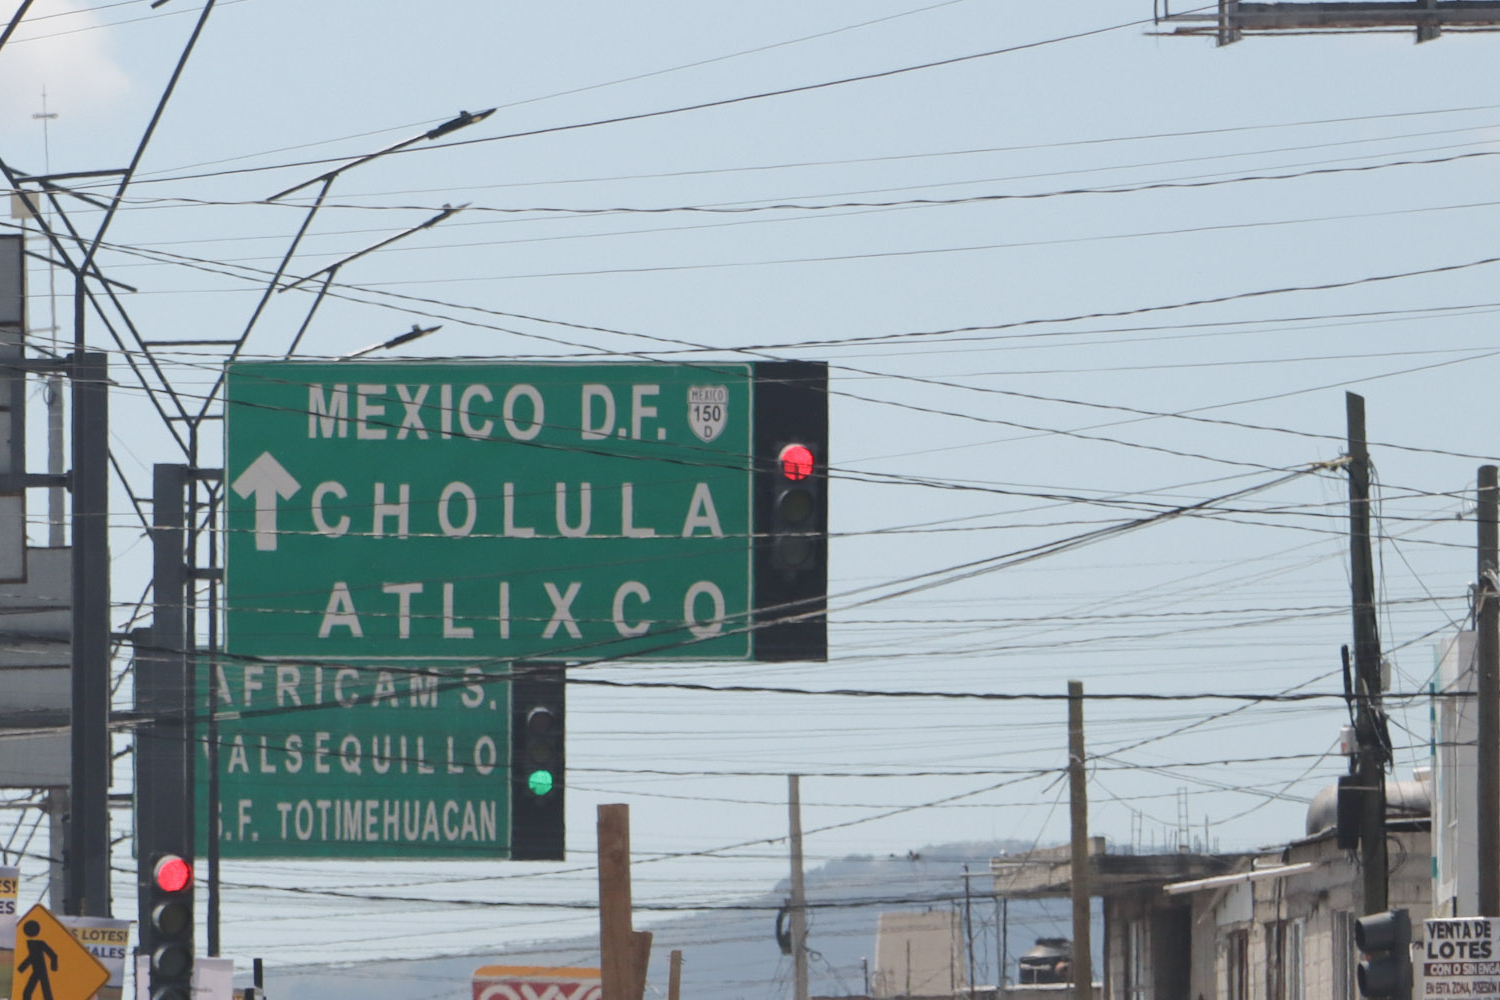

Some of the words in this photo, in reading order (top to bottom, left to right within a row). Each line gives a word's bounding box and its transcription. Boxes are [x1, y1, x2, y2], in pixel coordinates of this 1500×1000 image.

[691, 390, 724, 401] MEXICO
[308, 383, 545, 441] MEXICO
[581, 383, 666, 440] D.F.
[694, 405, 721, 422] 150
[704, 425, 713, 438] D
[311, 481, 724, 539] CHOLULA
[317, 581, 725, 640] ATLIXCO
[206, 664, 439, 708] AFRICAM
[461, 666, 497, 709] S.
[202, 733, 498, 776] VALSEQUILLO
[276, 800, 497, 842] TOTIMEHUACAN
[1427, 921, 1472, 939] VENTA
[1475, 920, 1492, 938] DE
[1427, 941, 1493, 959] LOTES
[1430, 963, 1452, 976] CON
[1453, 963, 1461, 975] O
[1462, 963, 1477, 975] SIN
[1426, 982, 1435, 994] EN
[1436, 981, 1451, 994] ESTA
